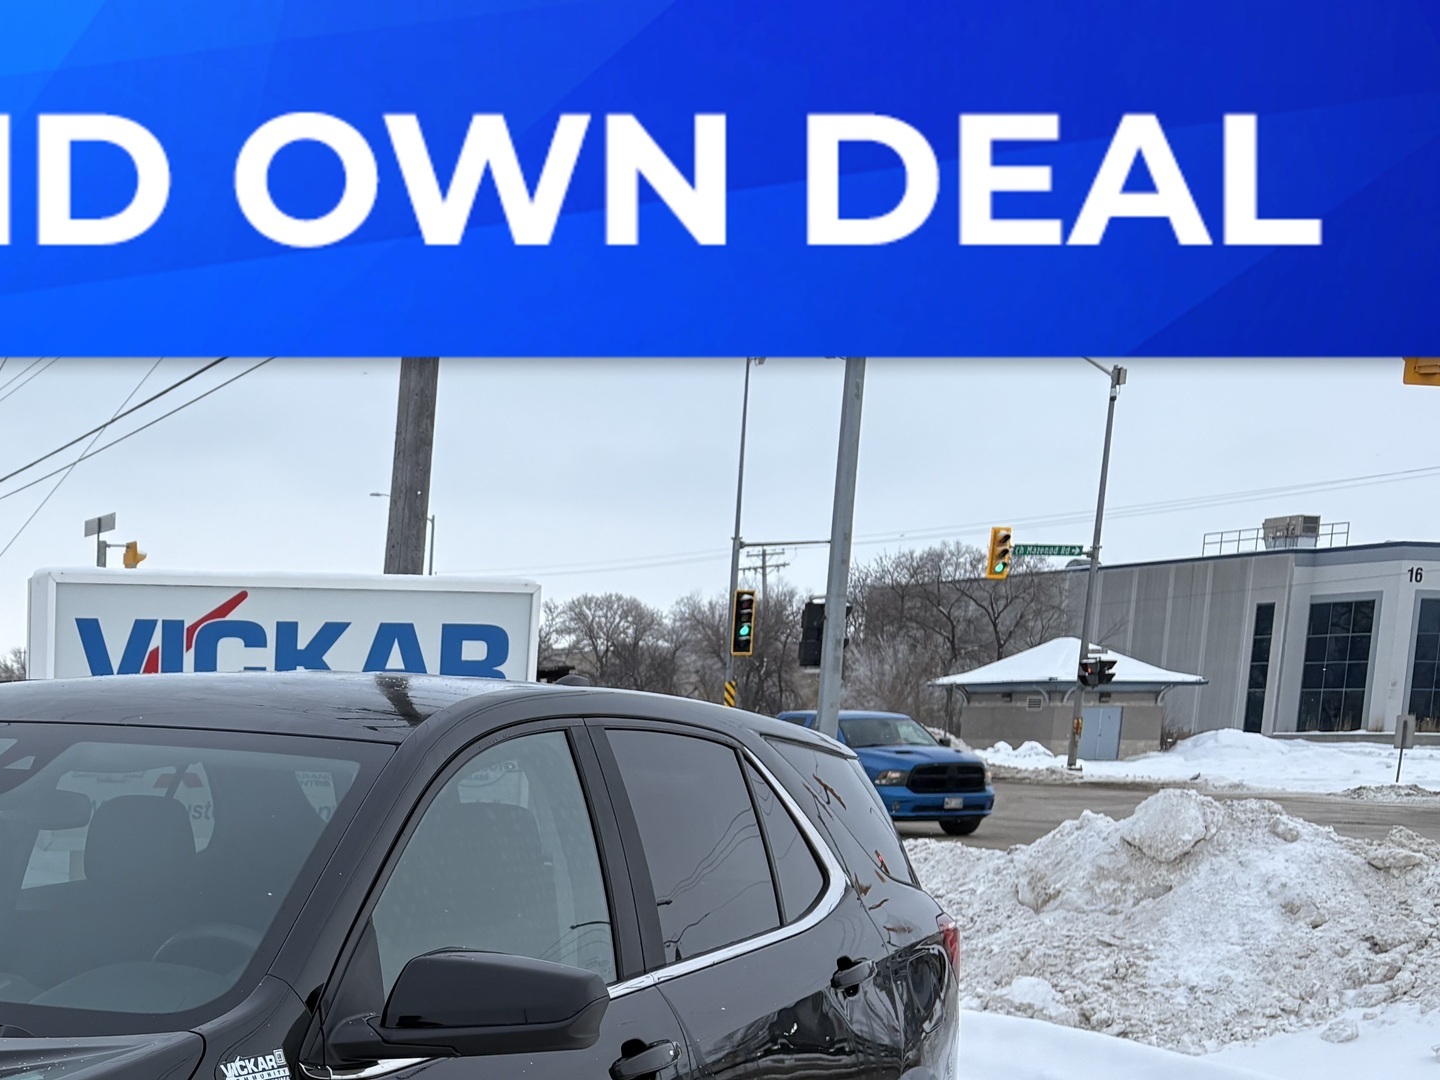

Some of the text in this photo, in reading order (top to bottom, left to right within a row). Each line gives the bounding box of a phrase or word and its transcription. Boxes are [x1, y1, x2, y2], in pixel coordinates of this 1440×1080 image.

[1026, 545, 1059, 555] Mazenod
[1060, 546, 1070, 555] Rd
[1407, 566, 1424, 583] 16
[74, 616, 511, 680] VICKAR
[220, 1053, 278, 1078] VICKAR
